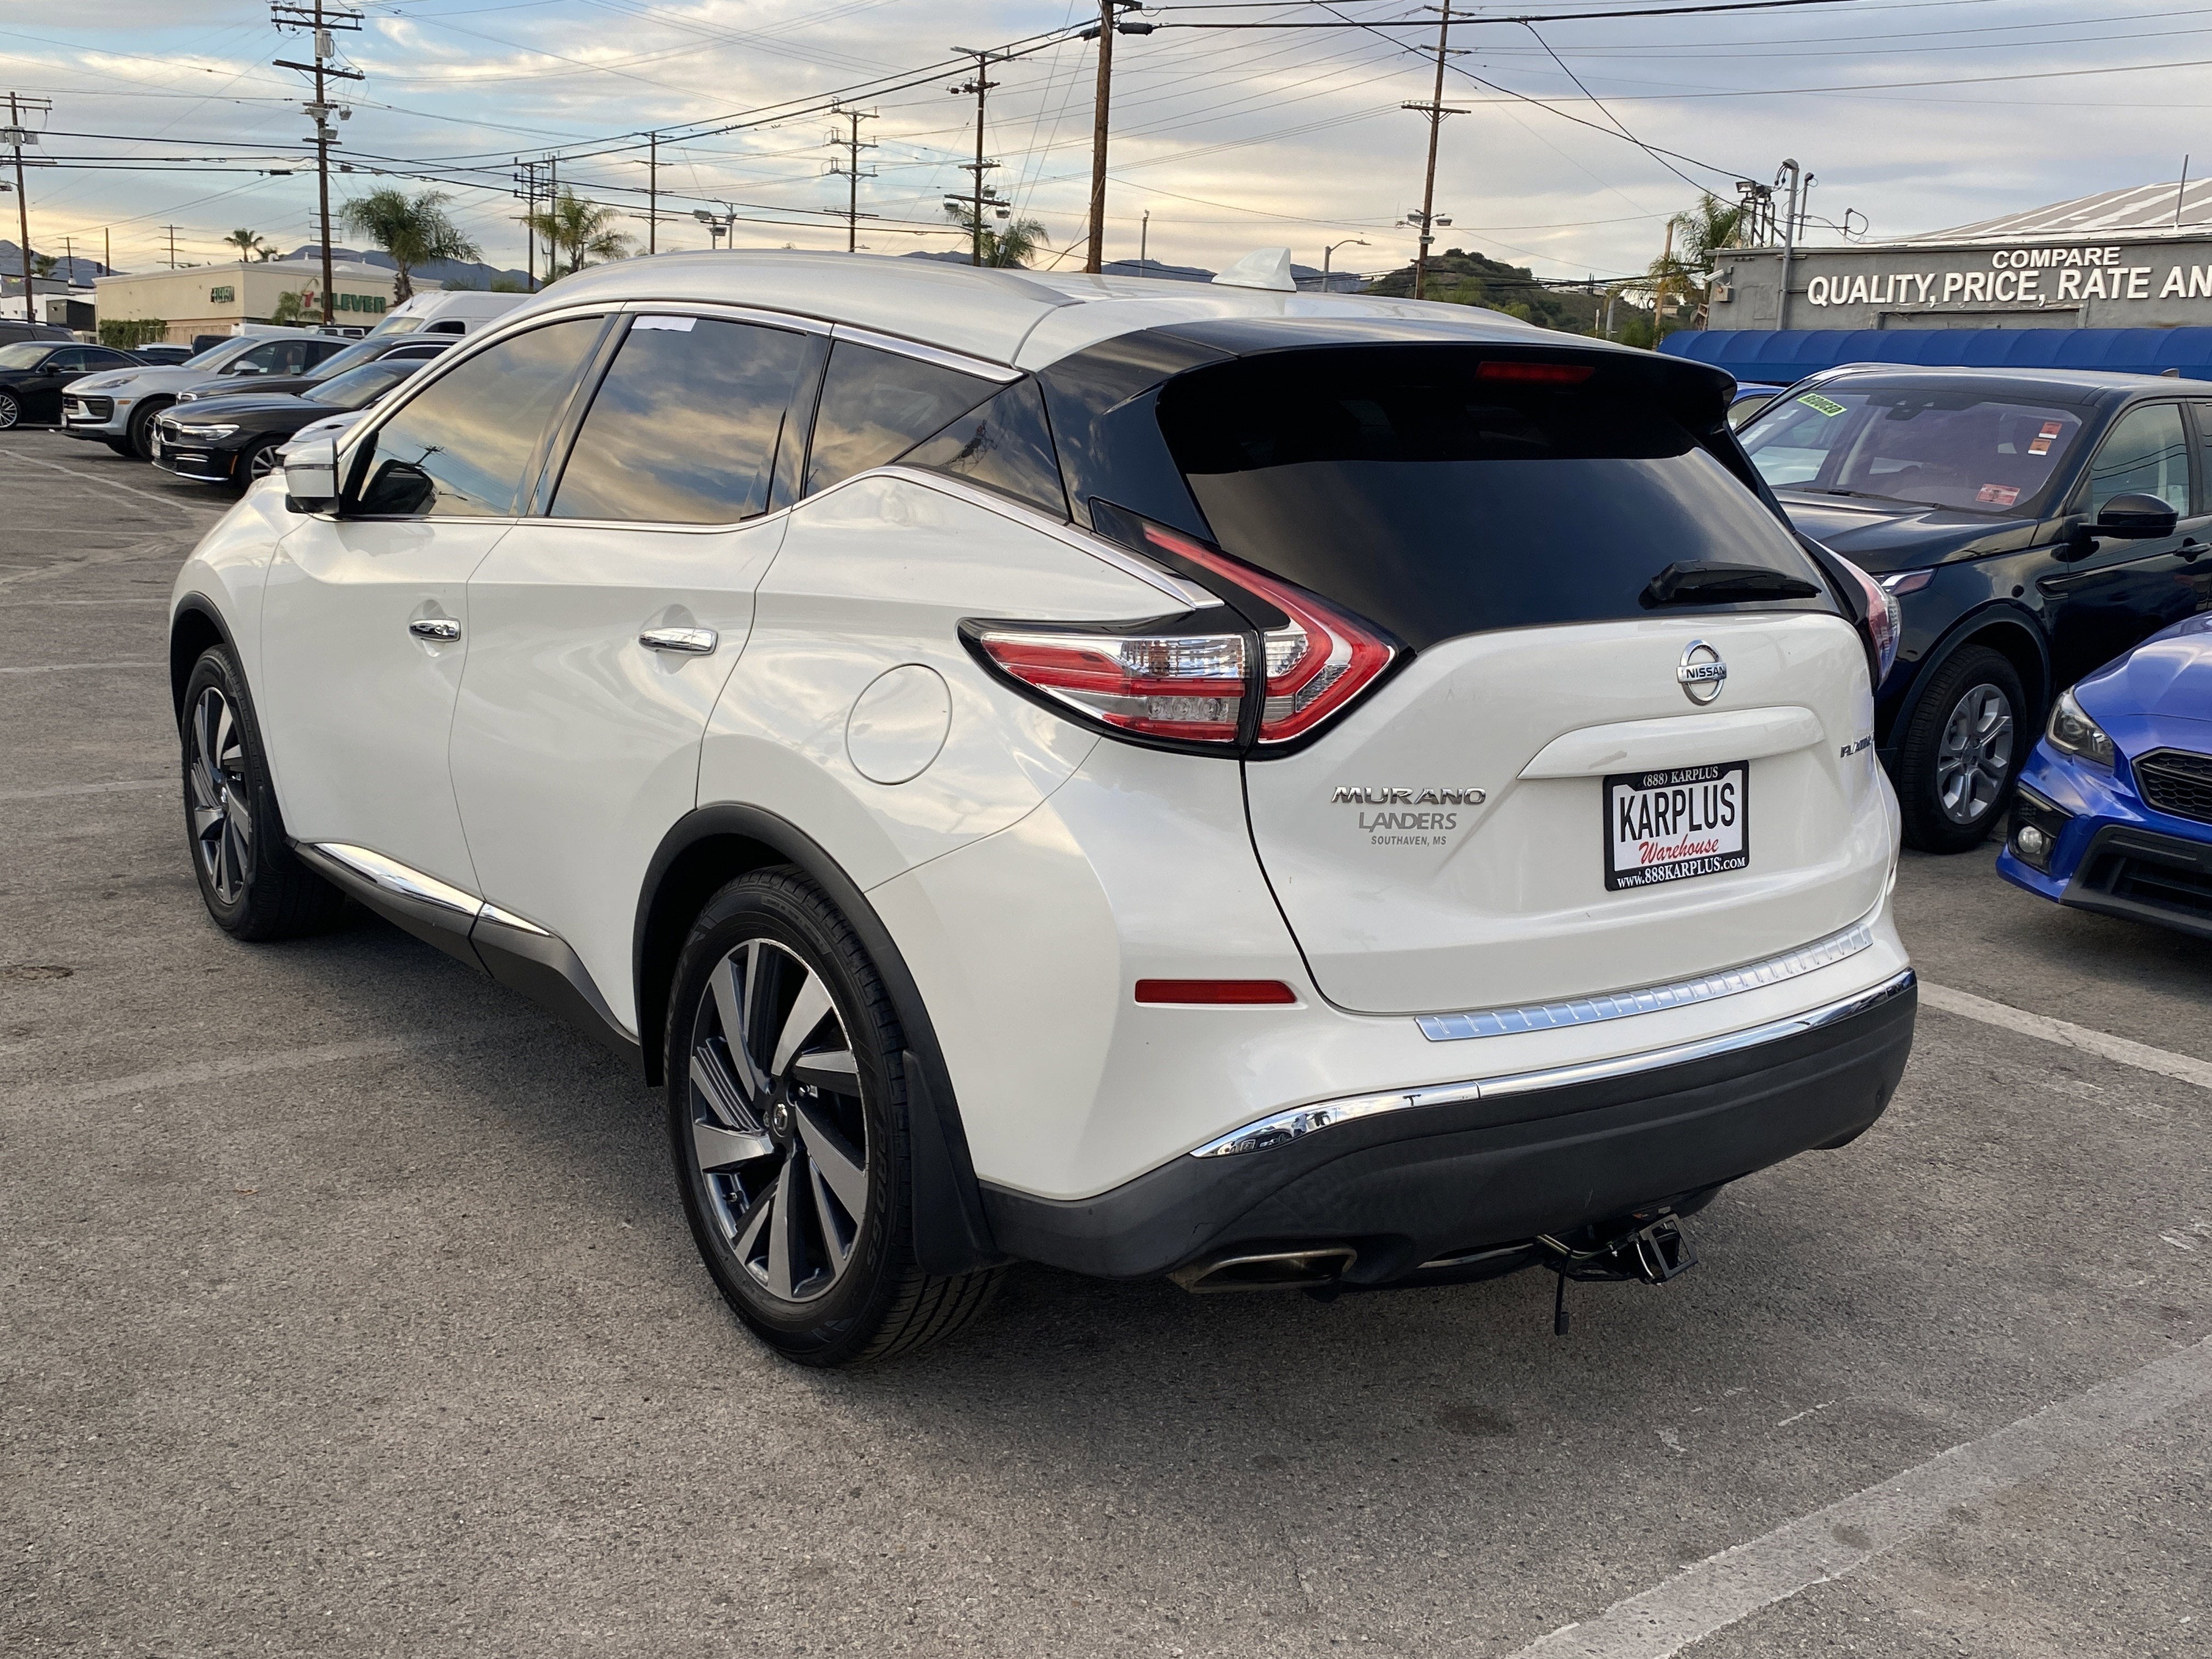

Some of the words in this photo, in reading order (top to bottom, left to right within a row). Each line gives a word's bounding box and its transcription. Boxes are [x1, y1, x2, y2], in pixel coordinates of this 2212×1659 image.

[1992, 247, 2121, 269] COMPARE
[1807, 273, 1937, 307] QUALITY,
[1943, 270, 2047, 307] PRICE,
[2057, 267, 2152, 301] RATE
[1686, 665, 1726, 679] NISSAN
[1643, 772, 1668, 787] (888)
[1671, 766, 1718, 784] KARPLUS
[1330, 786, 1486, 805] MURANO
[1358, 812, 1457, 833] LANDERS
[1620, 782, 1735, 843] KARPLUS
[1371, 836, 1430, 847] SOUTHAVEN,
[1433, 836, 1447, 845] MS
[1639, 833, 1719, 865] Warehouse
